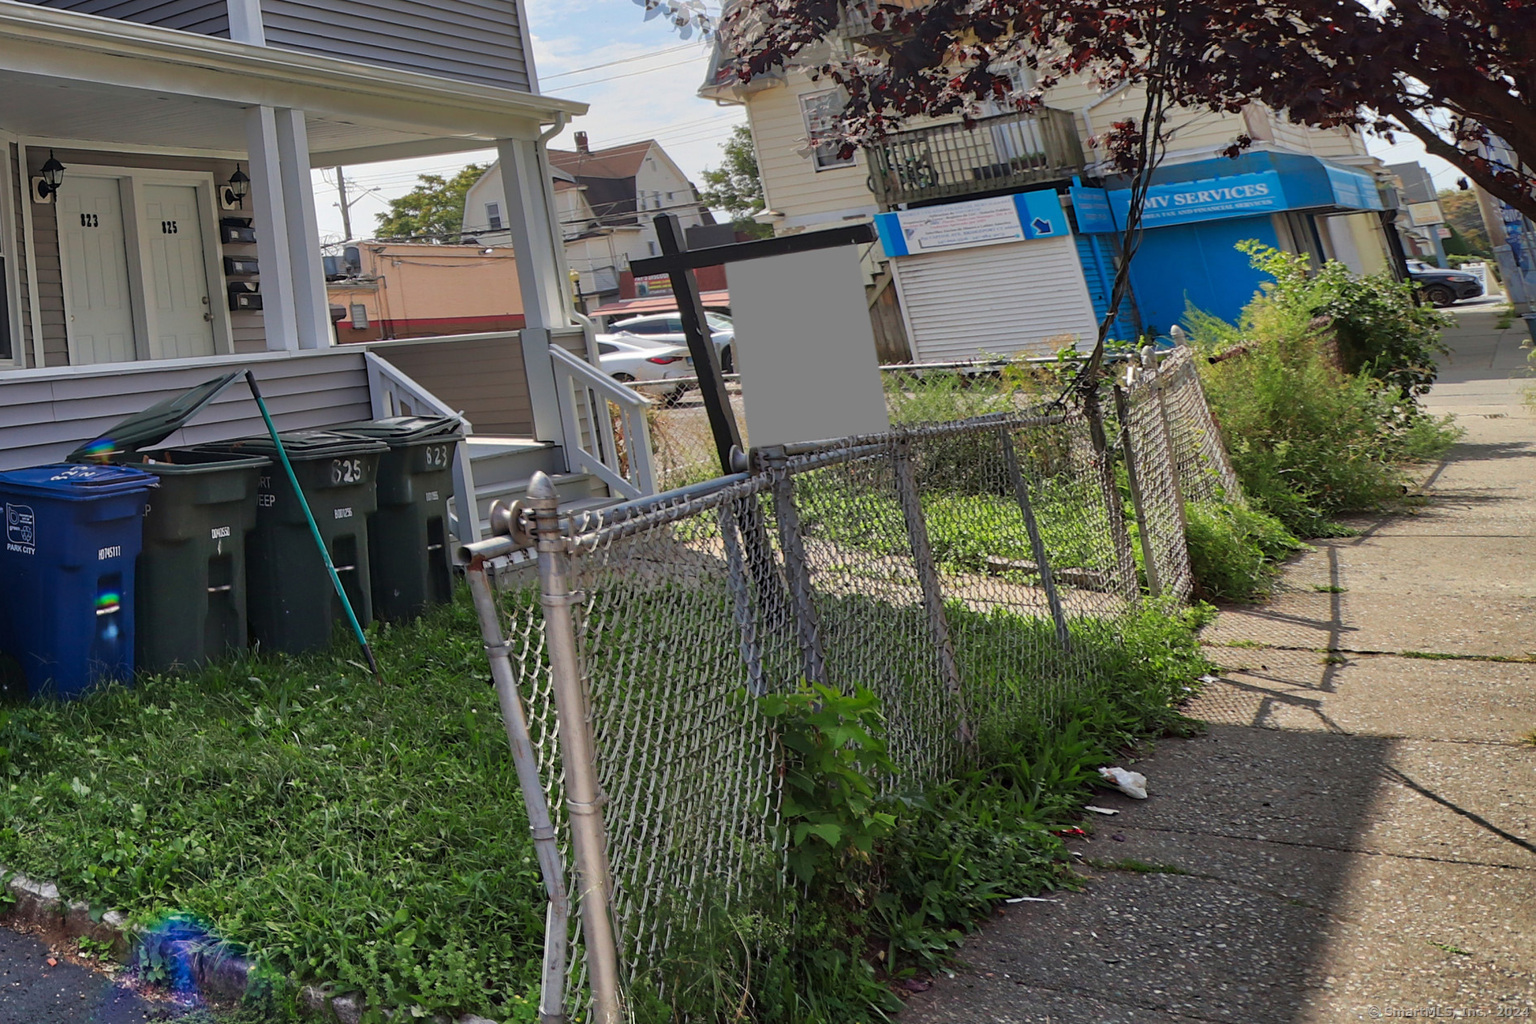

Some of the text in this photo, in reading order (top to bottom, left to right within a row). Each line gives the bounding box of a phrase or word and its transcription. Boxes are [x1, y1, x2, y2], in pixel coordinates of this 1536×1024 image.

[1131, 182, 1269, 211] MV SERVICES
[80, 213, 98, 227] 823
[162, 220, 178, 234] 825
[425, 445, 447, 467] 823
[258, 494, 276, 507] EEP
[7, 542, 36, 556] PARK CITY
